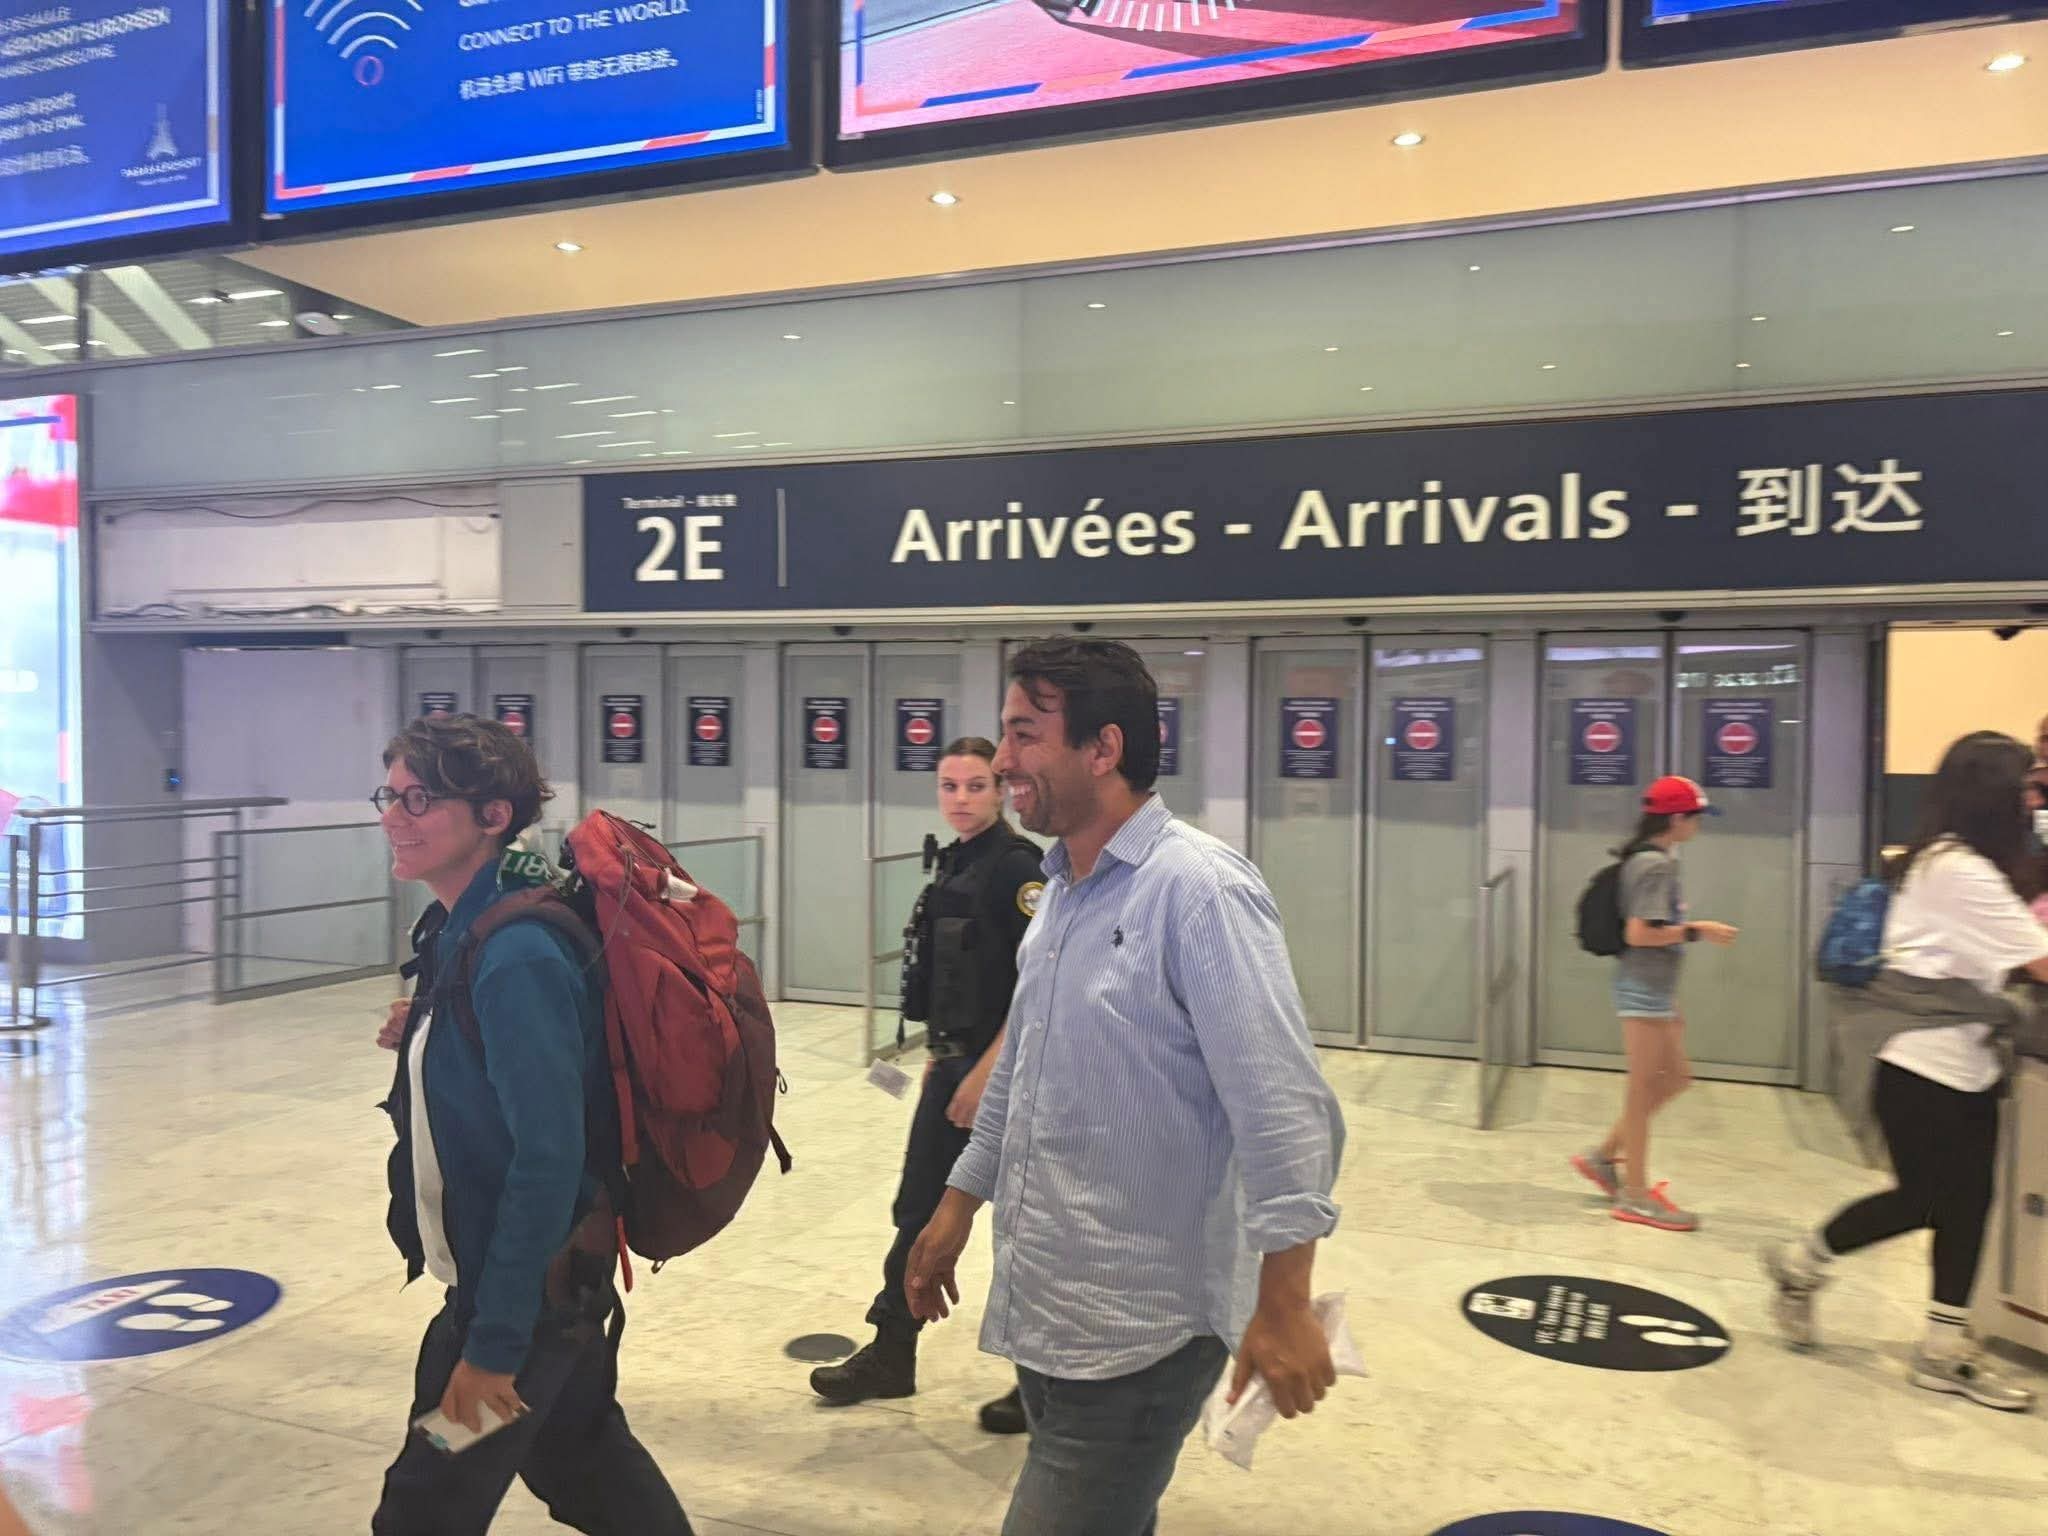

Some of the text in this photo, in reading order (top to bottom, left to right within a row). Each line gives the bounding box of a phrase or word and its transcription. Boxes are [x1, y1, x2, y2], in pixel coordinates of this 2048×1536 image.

[458, 21, 544, 50] CONNECT
[545, 17, 573, 35] TO
[574, 10, 614, 31] THE
[891, 459, 1923, 563] Arrivées - Arrivals - 到达
[636, 515, 724, 582] 2E
